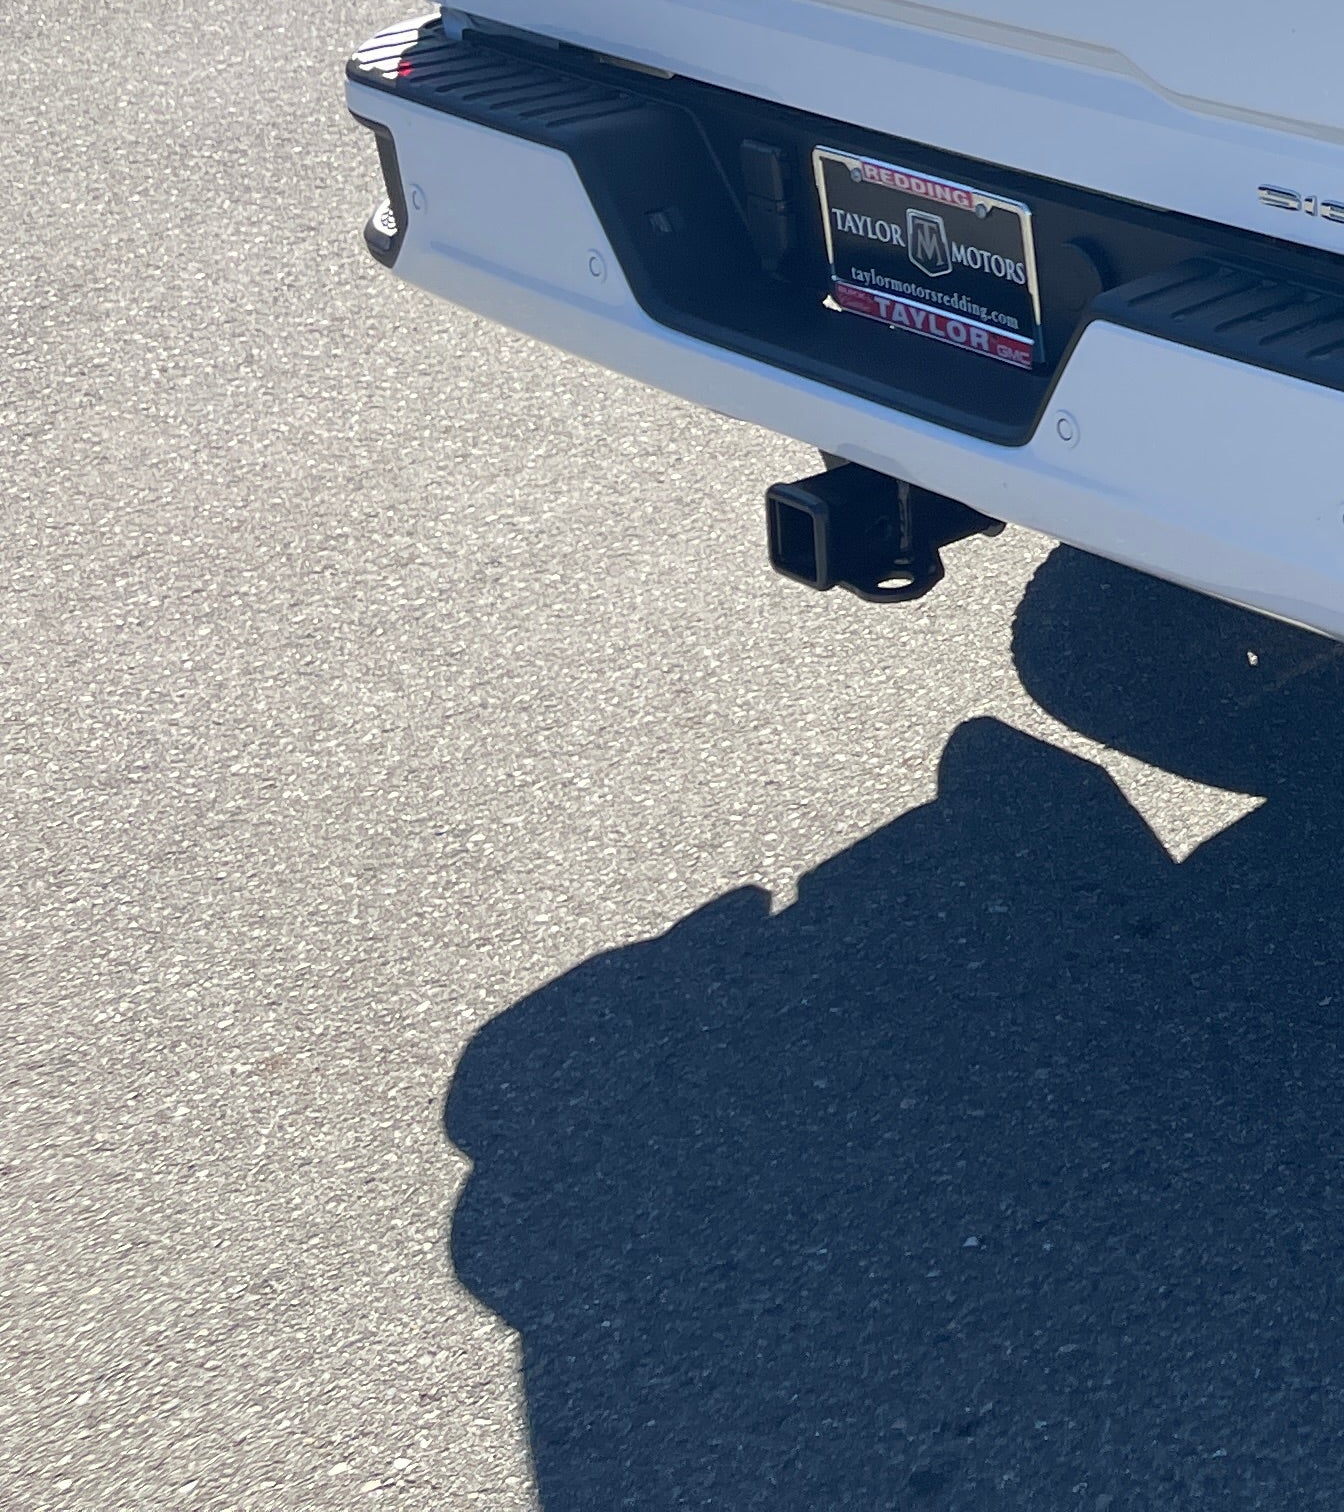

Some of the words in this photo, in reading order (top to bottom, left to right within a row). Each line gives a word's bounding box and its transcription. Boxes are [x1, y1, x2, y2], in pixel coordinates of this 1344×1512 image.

[862, 164, 971, 208] REDDING
[832, 208, 906, 247] TAYLOR
[951, 241, 1026, 285] MOTORS
[851, 266, 1020, 330] taylormotorsredding.com
[873, 295, 990, 351] TAYLOR
[996, 343, 1031, 365] GMC
